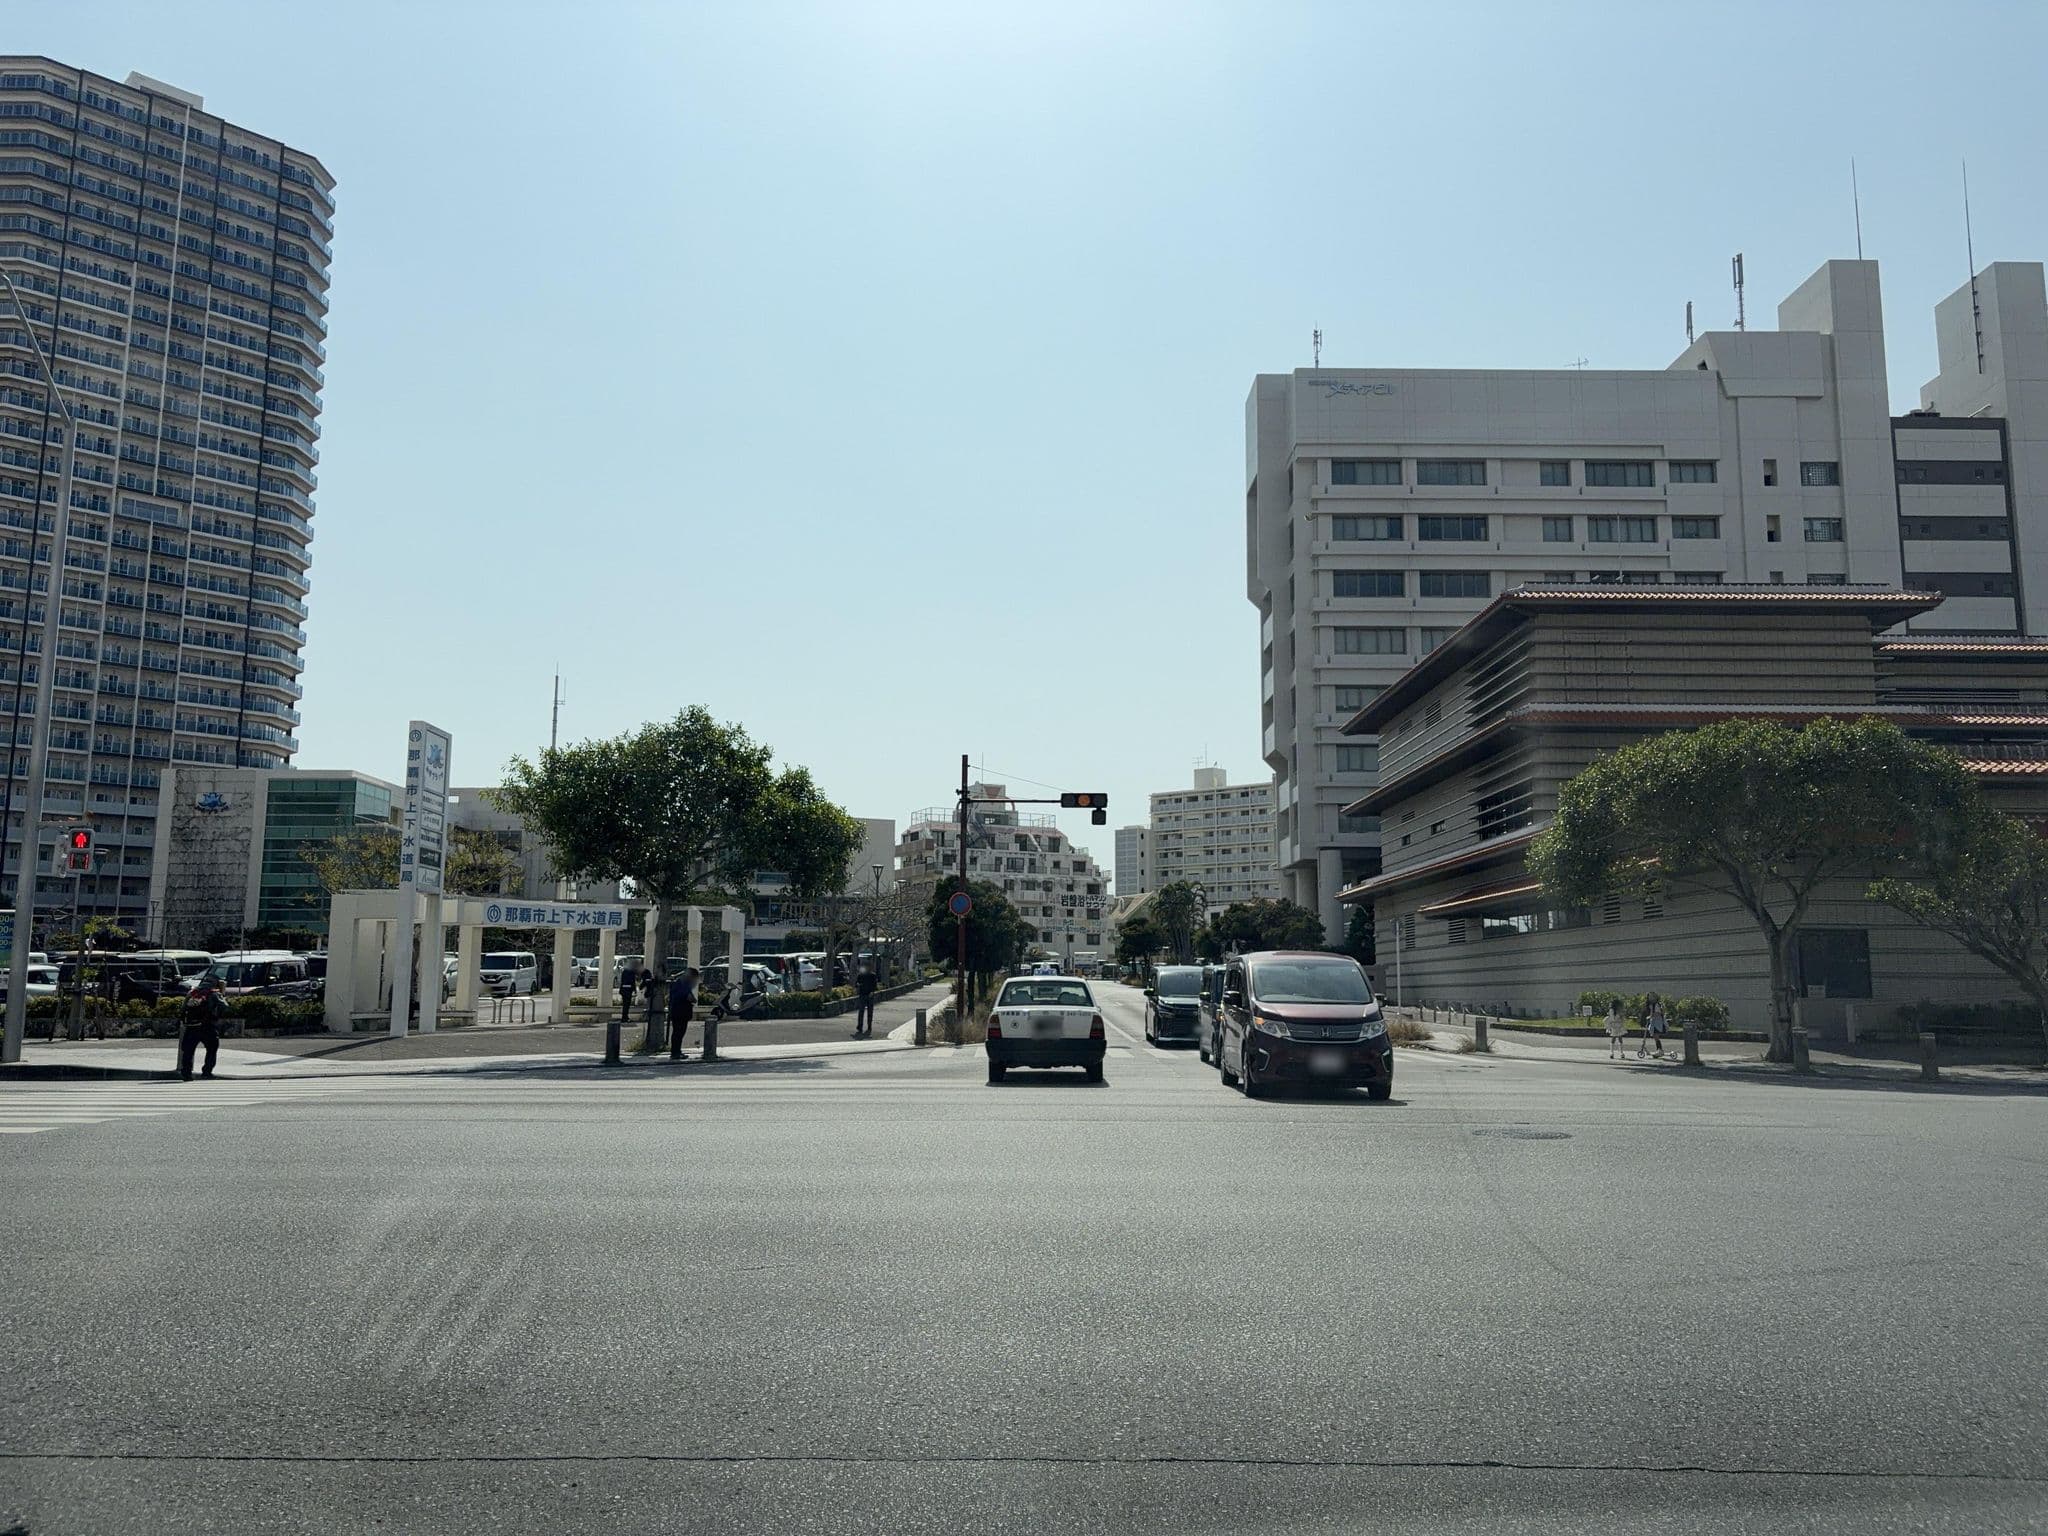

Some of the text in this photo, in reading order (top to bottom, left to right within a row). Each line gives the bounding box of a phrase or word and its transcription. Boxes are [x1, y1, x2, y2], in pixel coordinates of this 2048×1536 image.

[401, 749, 421, 883] 那覇市上下水道局
[1061, 893, 1085, 907] 岩盤浴
[505, 906, 623, 926] 那覇市上下水道局
